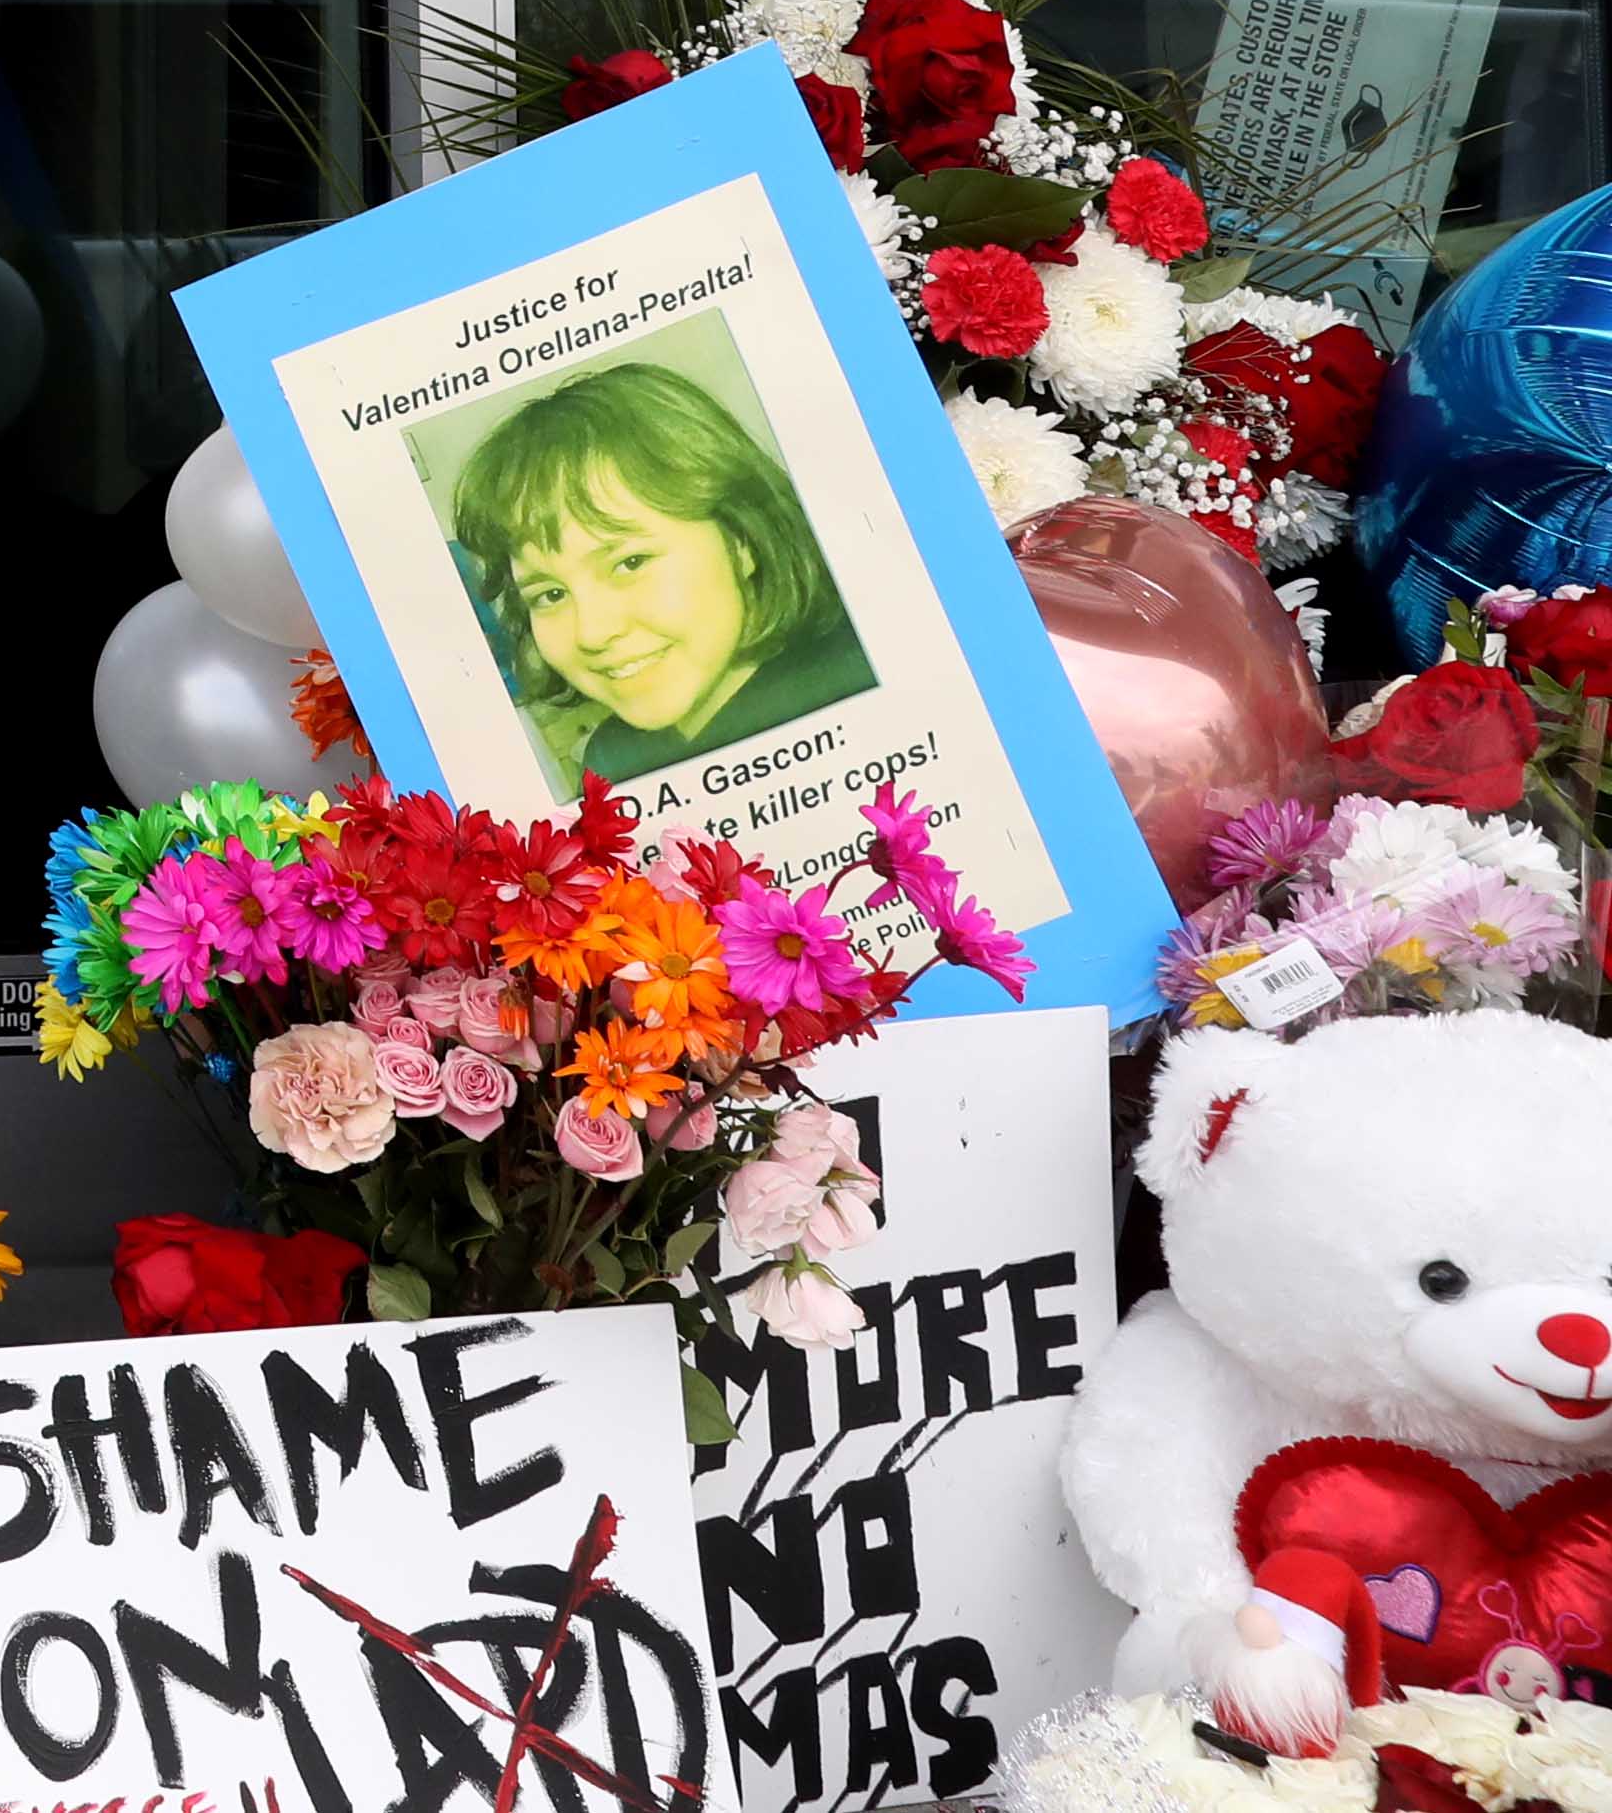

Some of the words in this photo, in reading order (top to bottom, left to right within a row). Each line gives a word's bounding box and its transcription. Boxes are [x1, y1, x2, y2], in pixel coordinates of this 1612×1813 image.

[1310, 11, 1348, 79] STORE
[1350, 7, 1368, 38] ORDER
[1285, 29, 1315, 71] ALL
[1342, 37, 1359, 66] LOCAL
[1248, 70, 1276, 115] ARE
[1277, 71, 1304, 102] AT
[1299, 80, 1327, 122] THE
[1329, 79, 1346, 108] STATE
[1260, 103, 1298, 171] MASK,
[1292, 123, 1316, 148] IN
[1319, 109, 1338, 149] FEDERAL,
[1255, 172, 1276, 191] A
[454, 290, 568, 349] Justice
[575, 269, 619, 304] for
[341, 362, 491, 432] Valentina
[498, 253, 754, 375] Orellana-Peralta!
[702, 722, 846, 797] Gascon:
[750, 775, 836, 831] killer
[844, 731, 940, 797] cops!
[876, 911, 928, 946] Poli
[694, 1251, 1083, 1469] MORE
[696, 1468, 920, 1674] NO
[0, 1549, 264, 1790] ON
[718, 1636, 999, 1806] MAS
